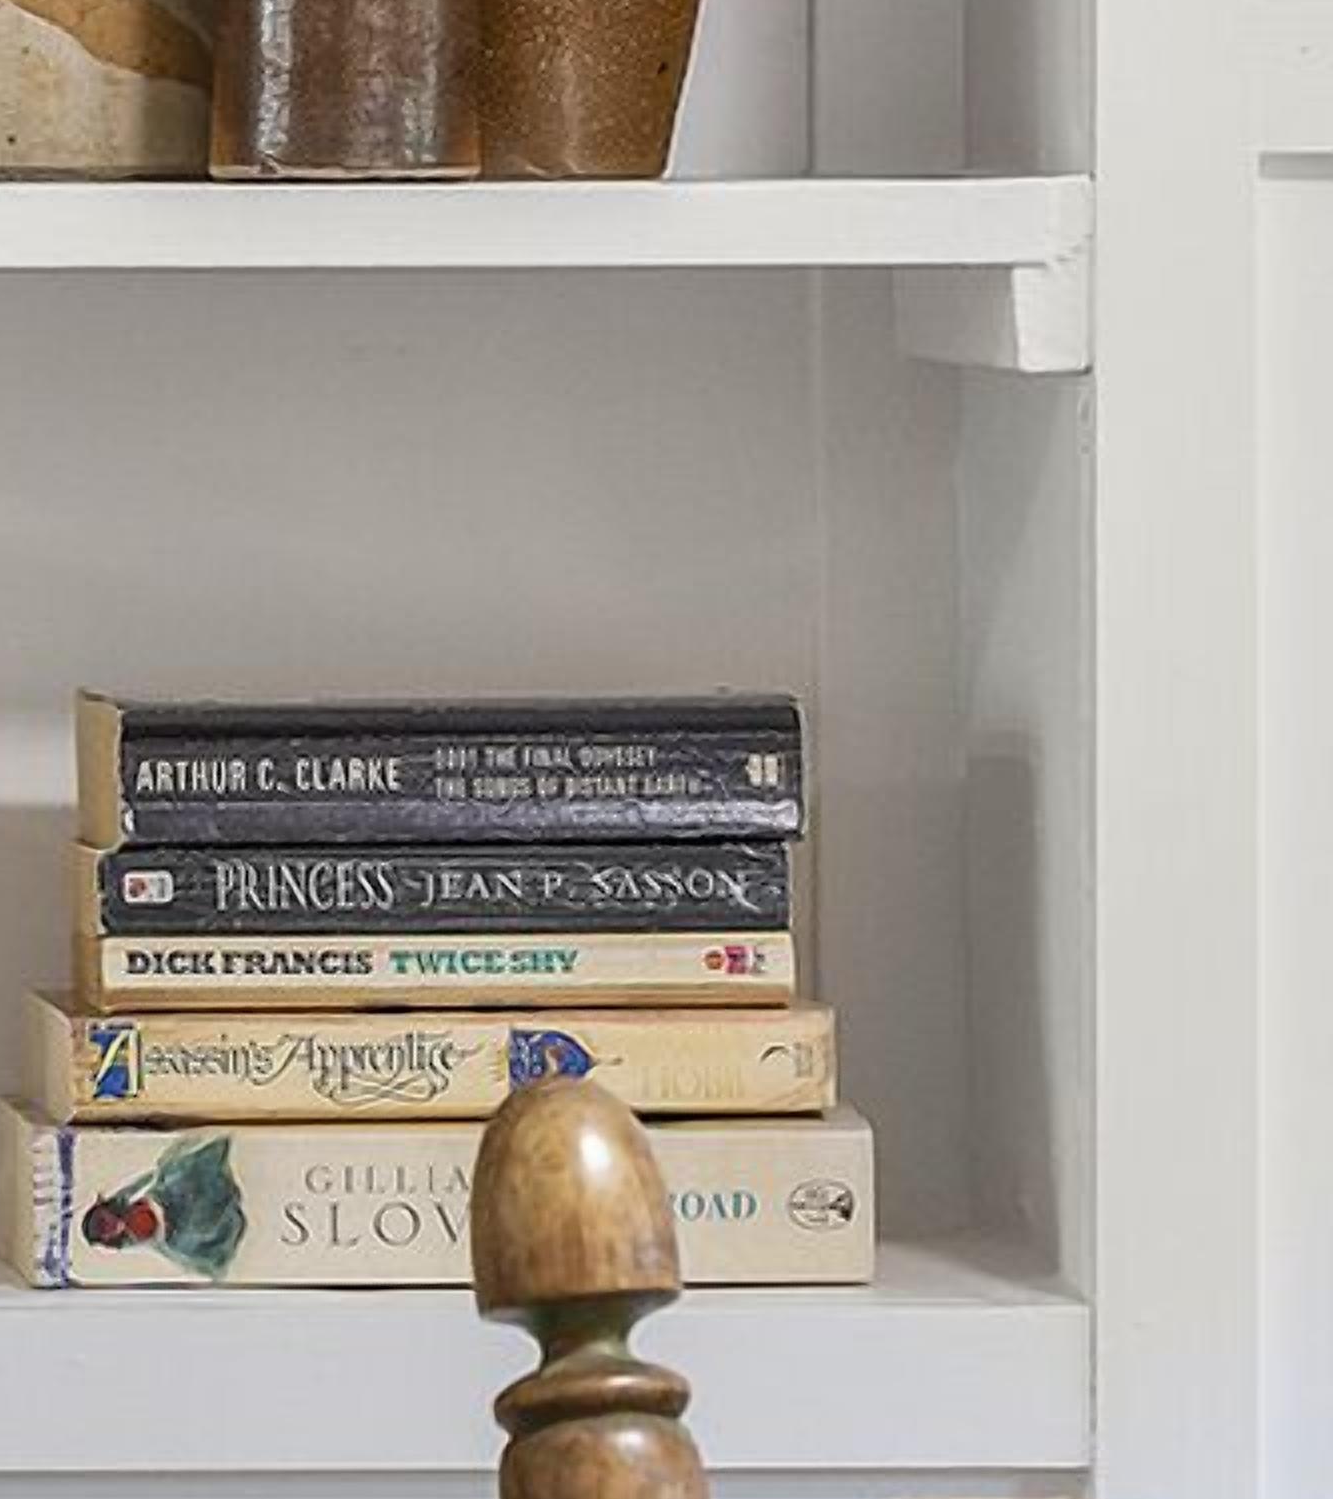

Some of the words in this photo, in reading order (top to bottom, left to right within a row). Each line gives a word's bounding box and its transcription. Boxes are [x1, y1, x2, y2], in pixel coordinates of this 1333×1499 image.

[136, 758, 247, 794] ARTHUR
[256, 757, 282, 792] C.
[296, 756, 403, 793] CLARKE
[215, 859, 396, 911] PRINCESS
[409, 867, 524, 907] JEAN
[590, 865, 761, 913] SASSON
[124, 949, 215, 976] DICK
[221, 949, 374, 976] FRANCIS
[389, 948, 505, 975] TWICE
[509, 948, 579, 975] SHY
[304, 1164, 471, 1196] GILLIA
[280, 1199, 471, 1248] SLOV
[669, 1189, 759, 1223] OAD
